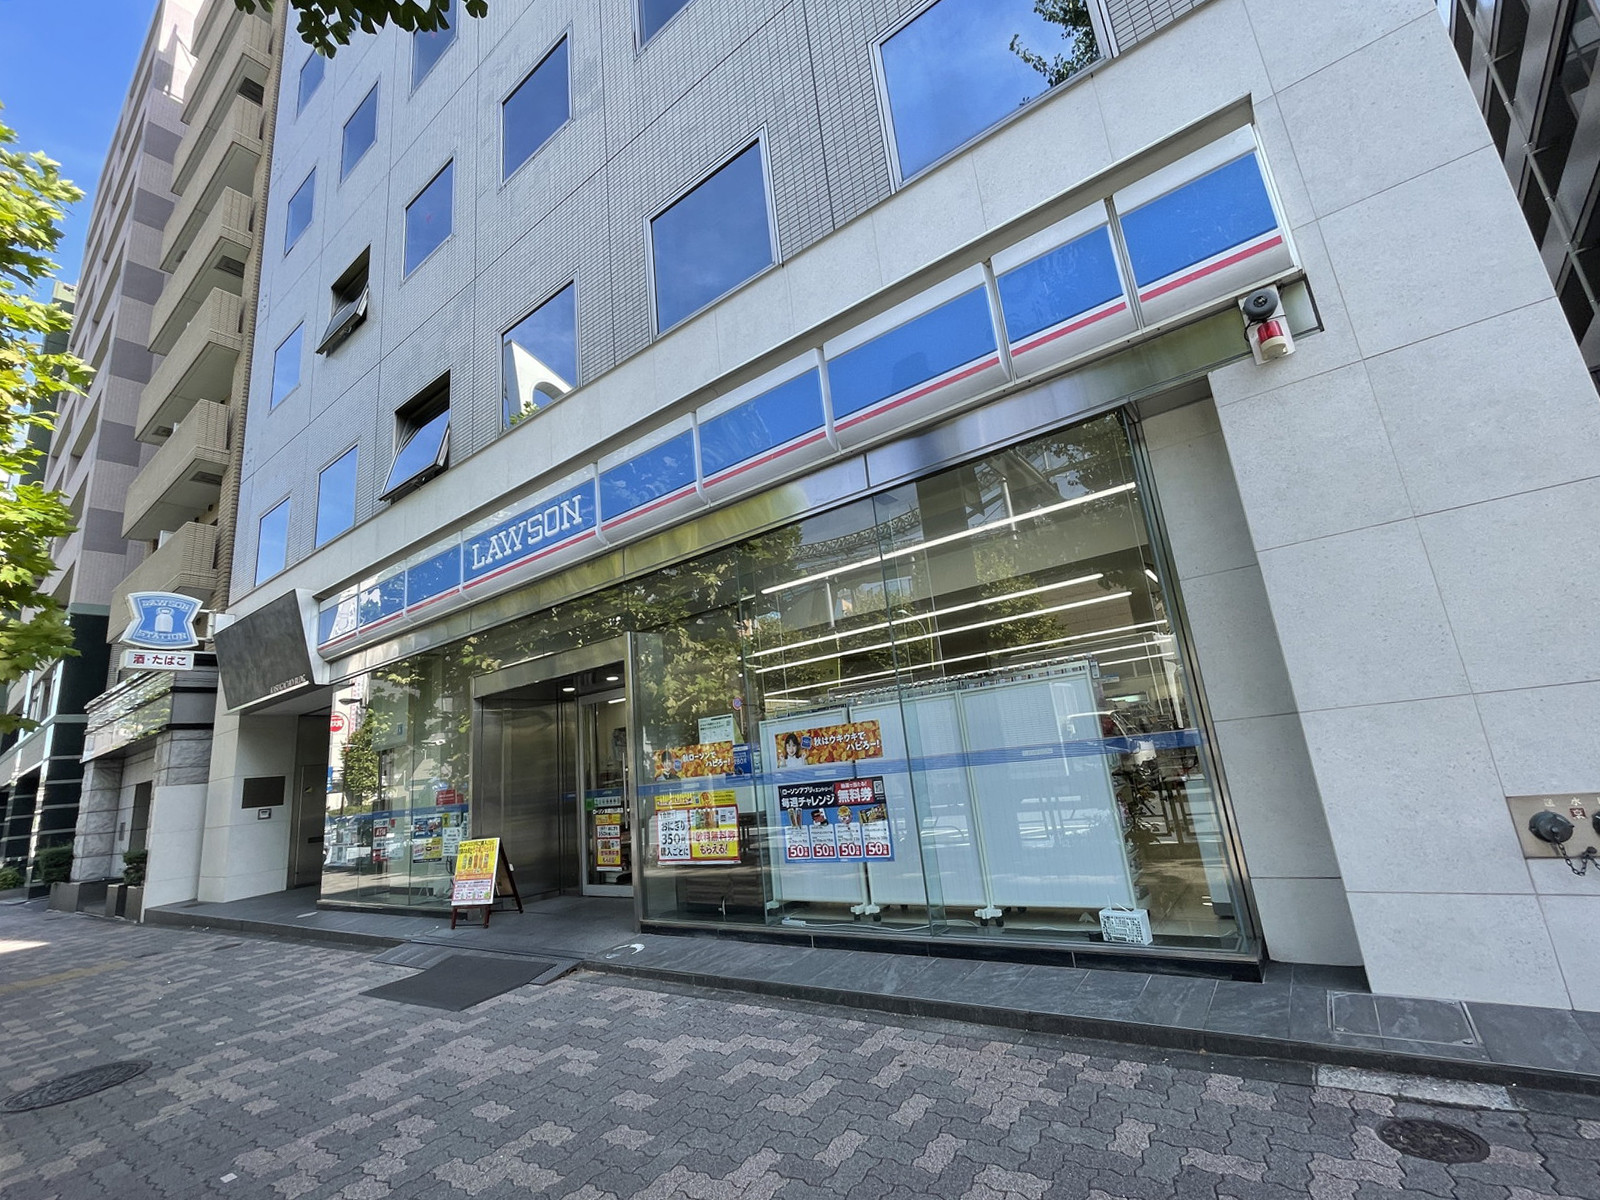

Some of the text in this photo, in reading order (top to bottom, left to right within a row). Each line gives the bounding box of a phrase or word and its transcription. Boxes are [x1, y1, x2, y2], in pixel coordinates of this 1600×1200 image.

[472, 494, 583, 571] LAWSON
[137, 629, 187, 640] STATION
[133, 653, 187, 666] 酒・たばこ
[813, 731, 867, 747] 秋はウキウキで
[781, 794, 835, 809] 毎週チャレンジ
[837, 788, 873, 804] 無料券
[661, 820, 686, 832] おにぎり
[700, 844, 728, 855] もらえる!
